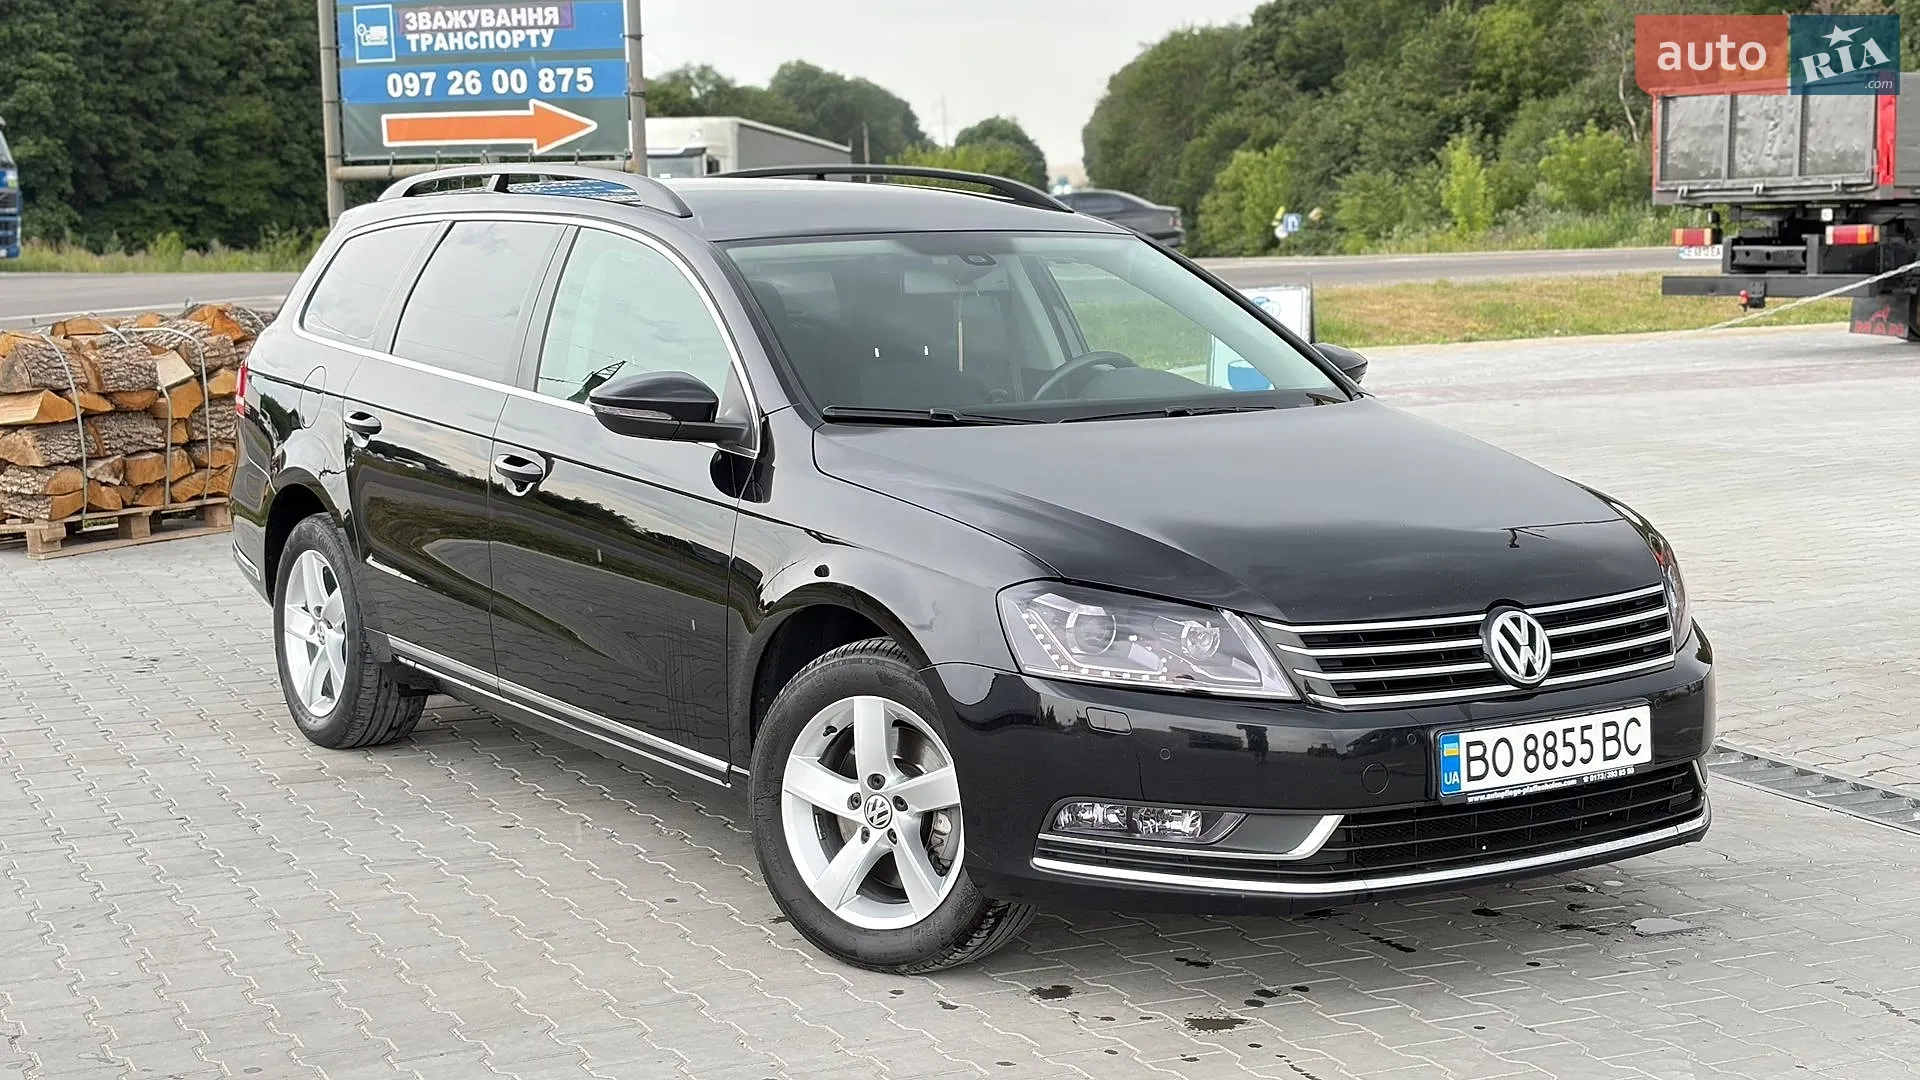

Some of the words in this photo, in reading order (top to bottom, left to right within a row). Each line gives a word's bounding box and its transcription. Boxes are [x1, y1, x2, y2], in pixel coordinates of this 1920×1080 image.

[405, 6, 560, 31] ЗВАЖУВАННЯ
[405, 29, 555, 52] ТРАНСПОРТУ
[386, 71, 437, 98] 097
[447, 70, 482, 96] 26
[492, 69, 528, 94] 00
[538, 67, 595, 92] 875
[1855, 320, 1905, 337] MAN
[1466, 736, 1514, 783] BO
[1523, 724, 1594, 774] 8855
[1602, 717, 1642, 762] BC
[1443, 771, 1461, 786] UA
